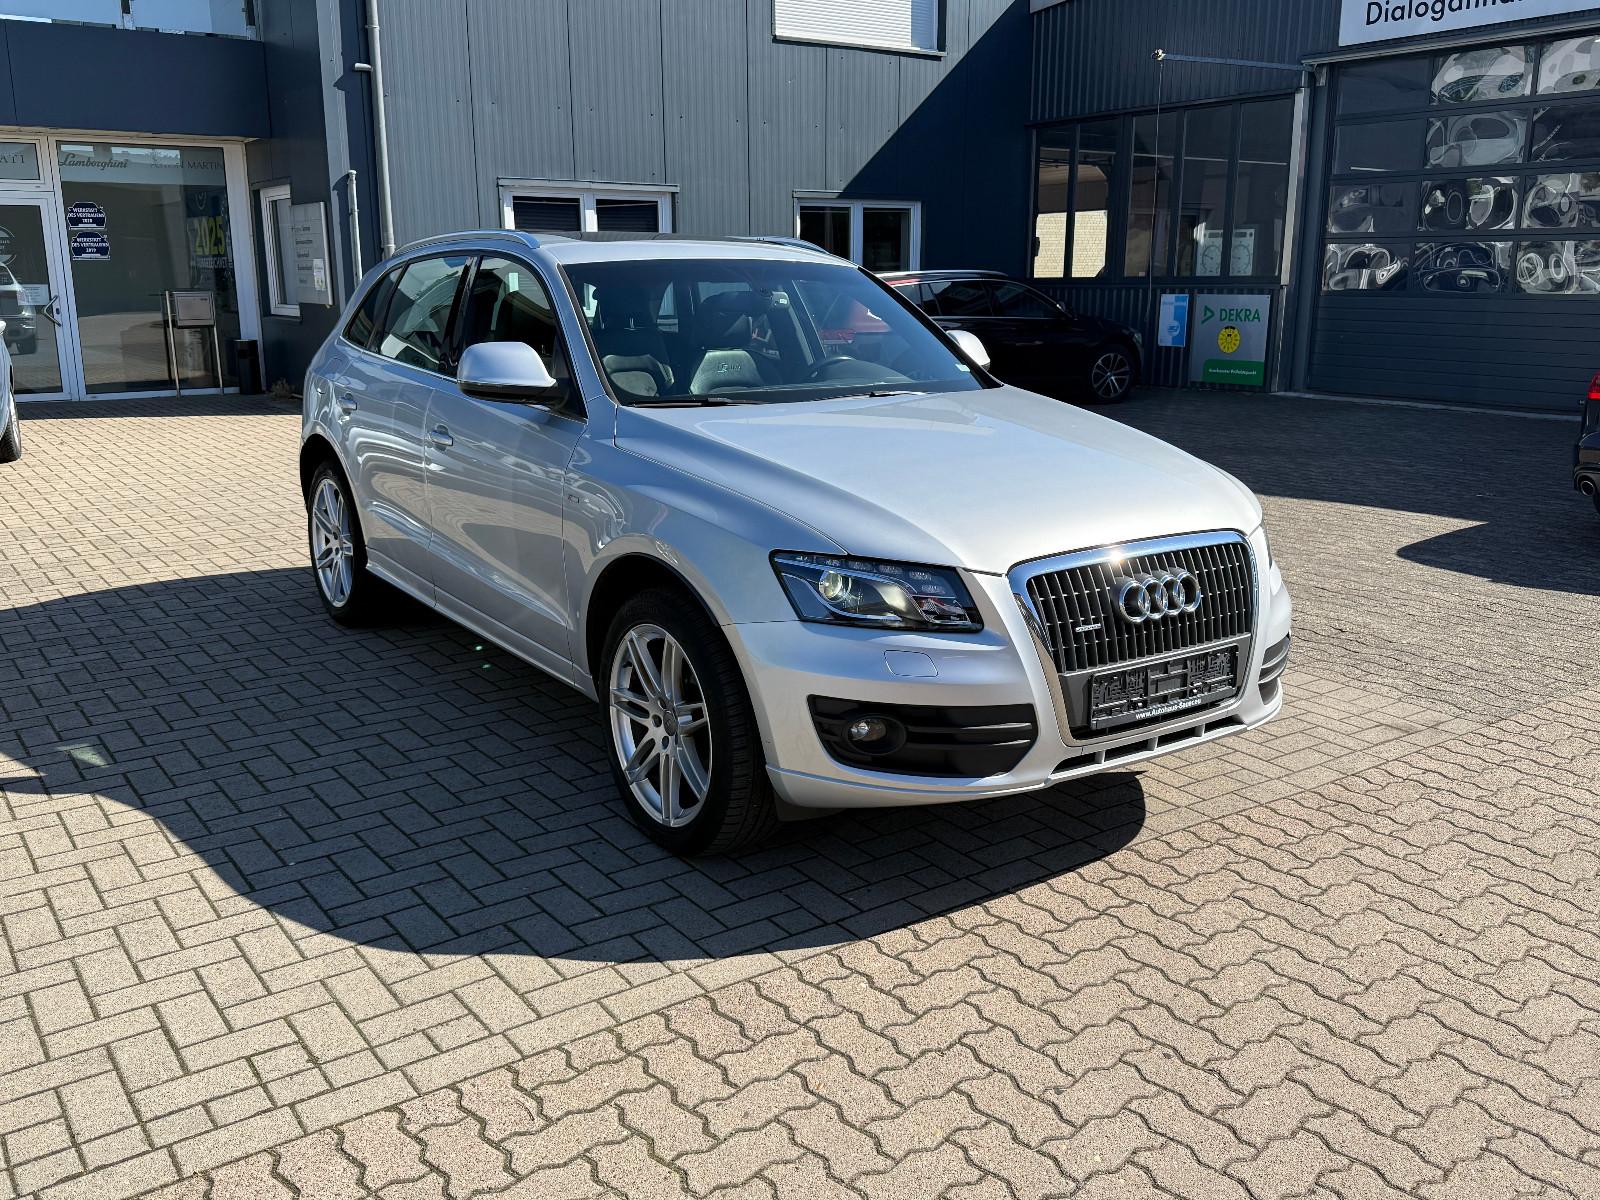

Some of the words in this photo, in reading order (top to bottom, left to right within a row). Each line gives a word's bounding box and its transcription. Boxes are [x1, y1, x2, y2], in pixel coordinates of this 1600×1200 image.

[58, 152, 128, 171] Lamborghini
[194, 216, 225, 255] 2025
[1219, 308, 1261, 322] DEKRA
